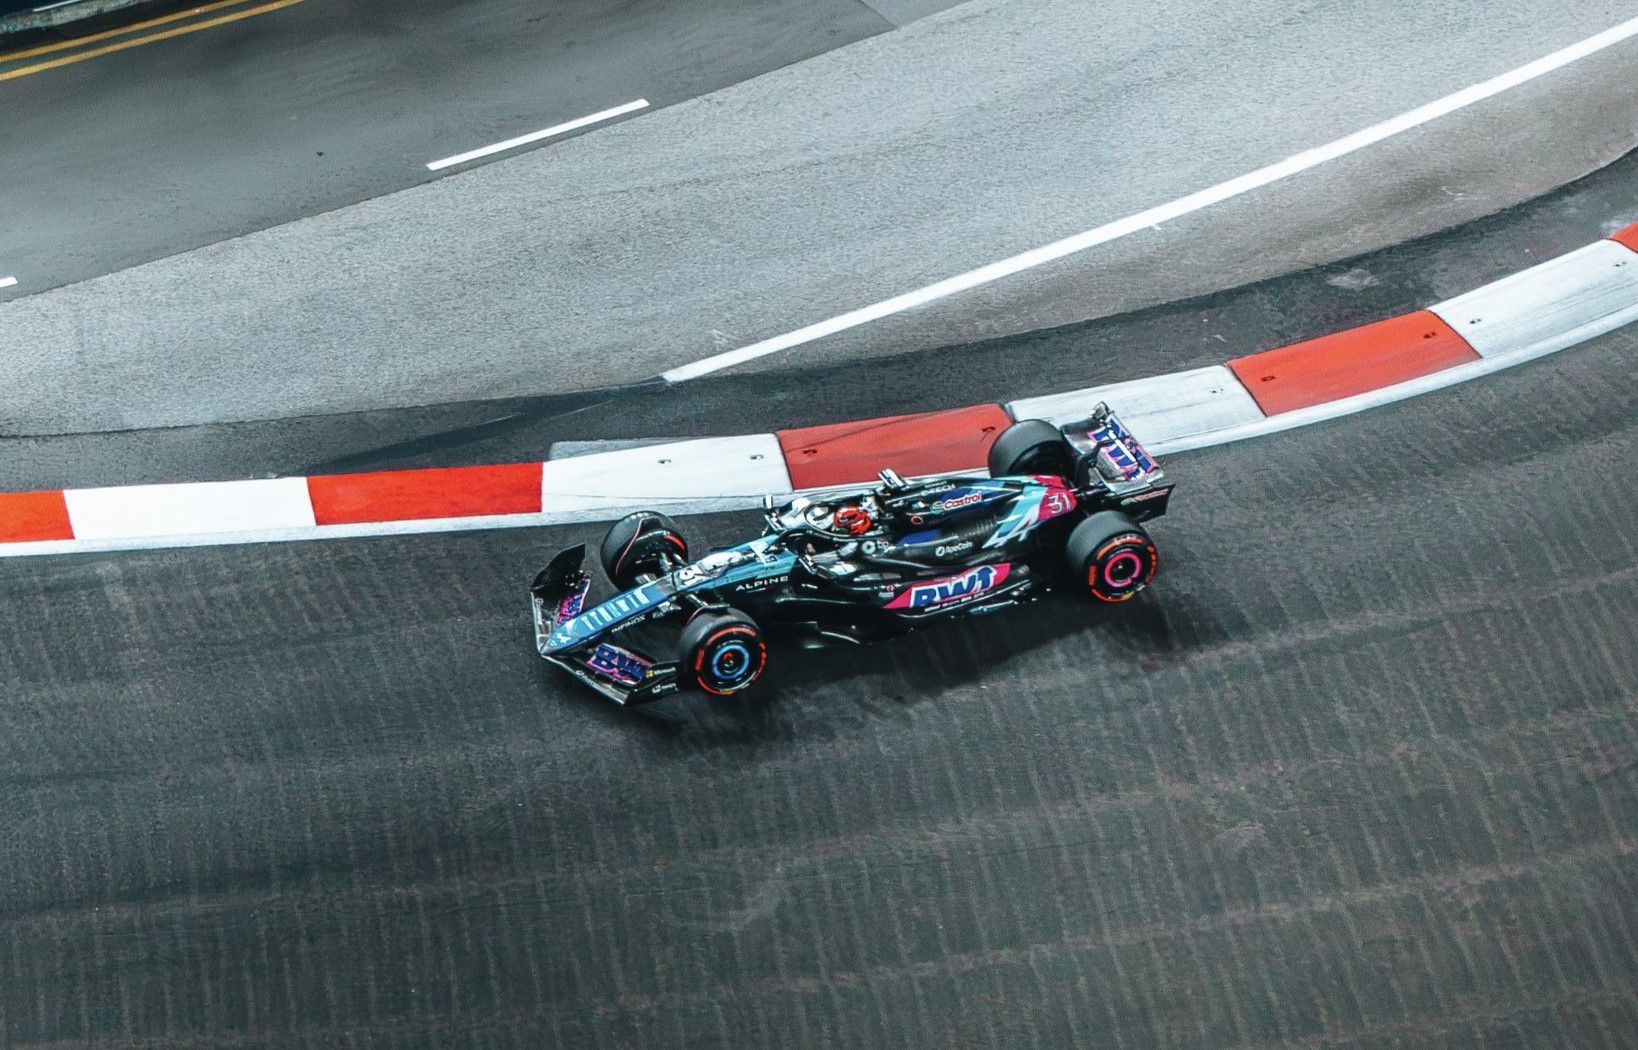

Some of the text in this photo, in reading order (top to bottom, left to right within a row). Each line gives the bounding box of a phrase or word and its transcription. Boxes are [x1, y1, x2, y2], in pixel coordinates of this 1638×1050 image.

[943, 490, 983, 511] Castrol
[1048, 493, 1071, 514] 31
[735, 575, 789, 591] ALPINE
[909, 565, 997, 609] BWT
